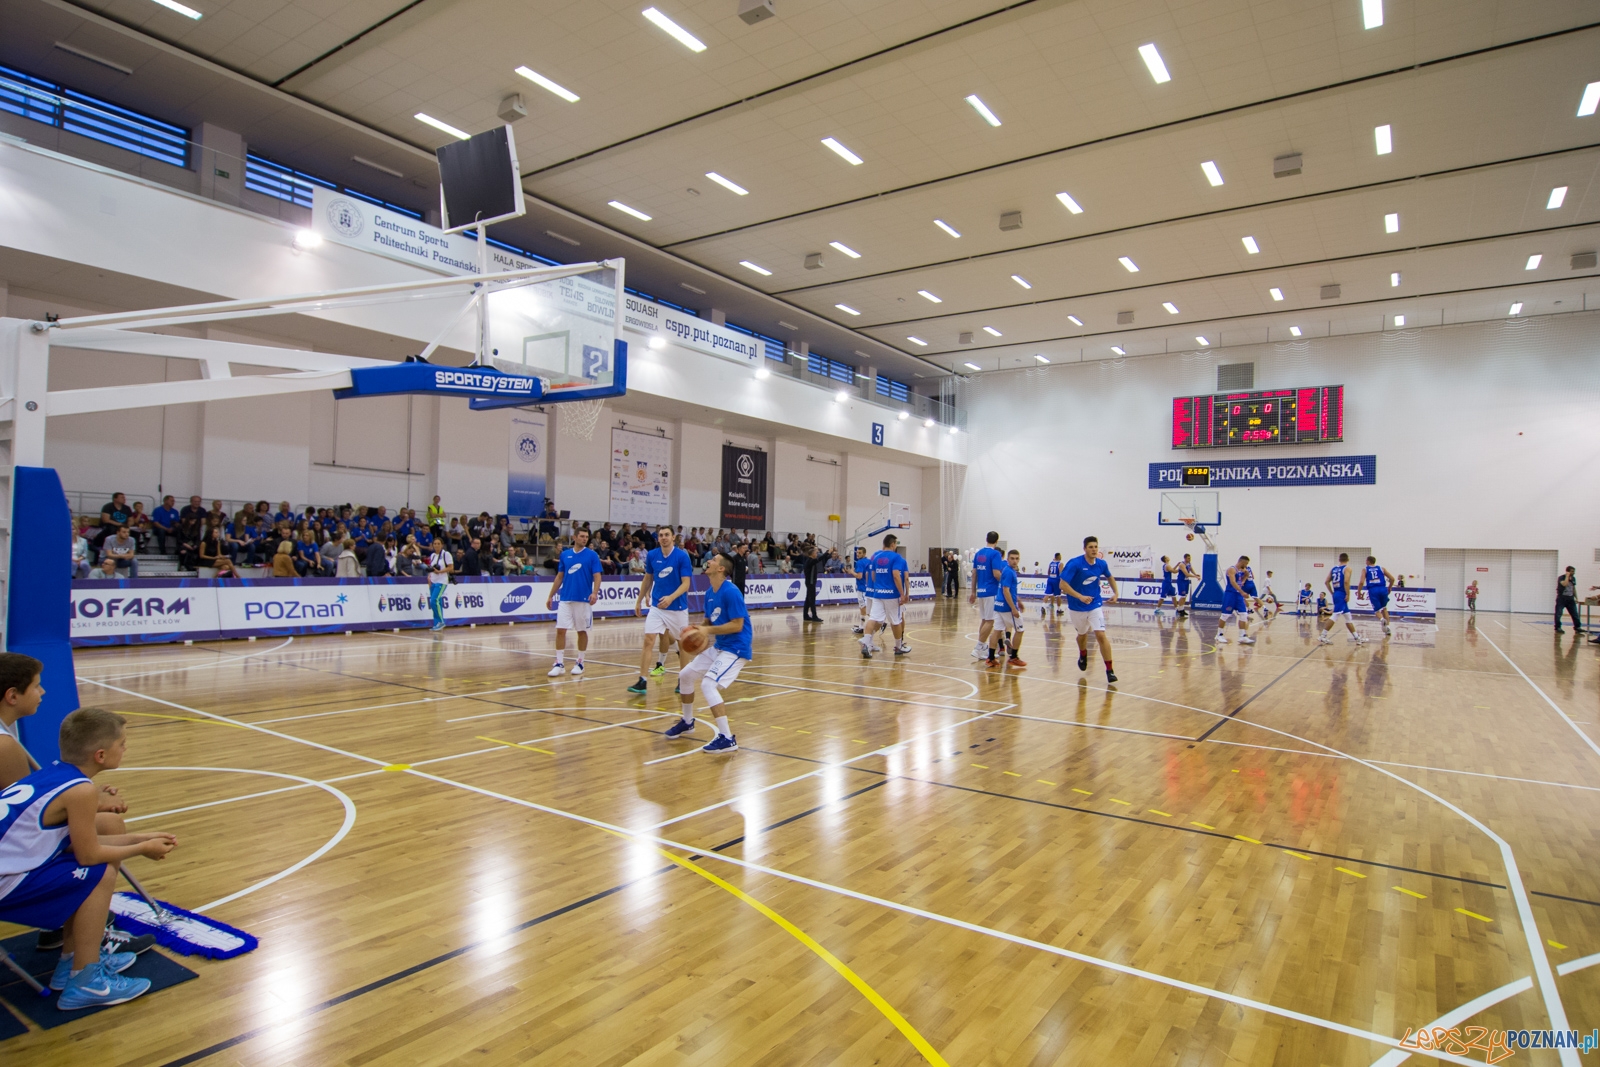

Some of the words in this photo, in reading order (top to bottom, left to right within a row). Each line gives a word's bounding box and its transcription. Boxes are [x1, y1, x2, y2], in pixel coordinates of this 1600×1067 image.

[374, 215, 416, 238] Centrum
[418, 231, 449, 249] Sportu
[373, 231, 429, 258] Politechniki
[493, 253, 514, 267] HALA
[587, 301, 615, 319] BOWLIN
[626, 298, 659, 318] SQUASH
[665, 318, 758, 359] cspp.put.poznan.pl
[589, 350, 603, 377] 2
[874, 426, 883, 443] 3
[1158, 466, 1262, 482] POLCHNIKA
[1267, 462, 1364, 479] POZNAŃSKA
[463, 595, 484, 609] PBG
[597, 587, 641, 600] BIOFAR
[70, 597, 190, 619] IOFARM
[388, 597, 412, 611] PBG
[96, 619, 148, 628] PRODUCENT
